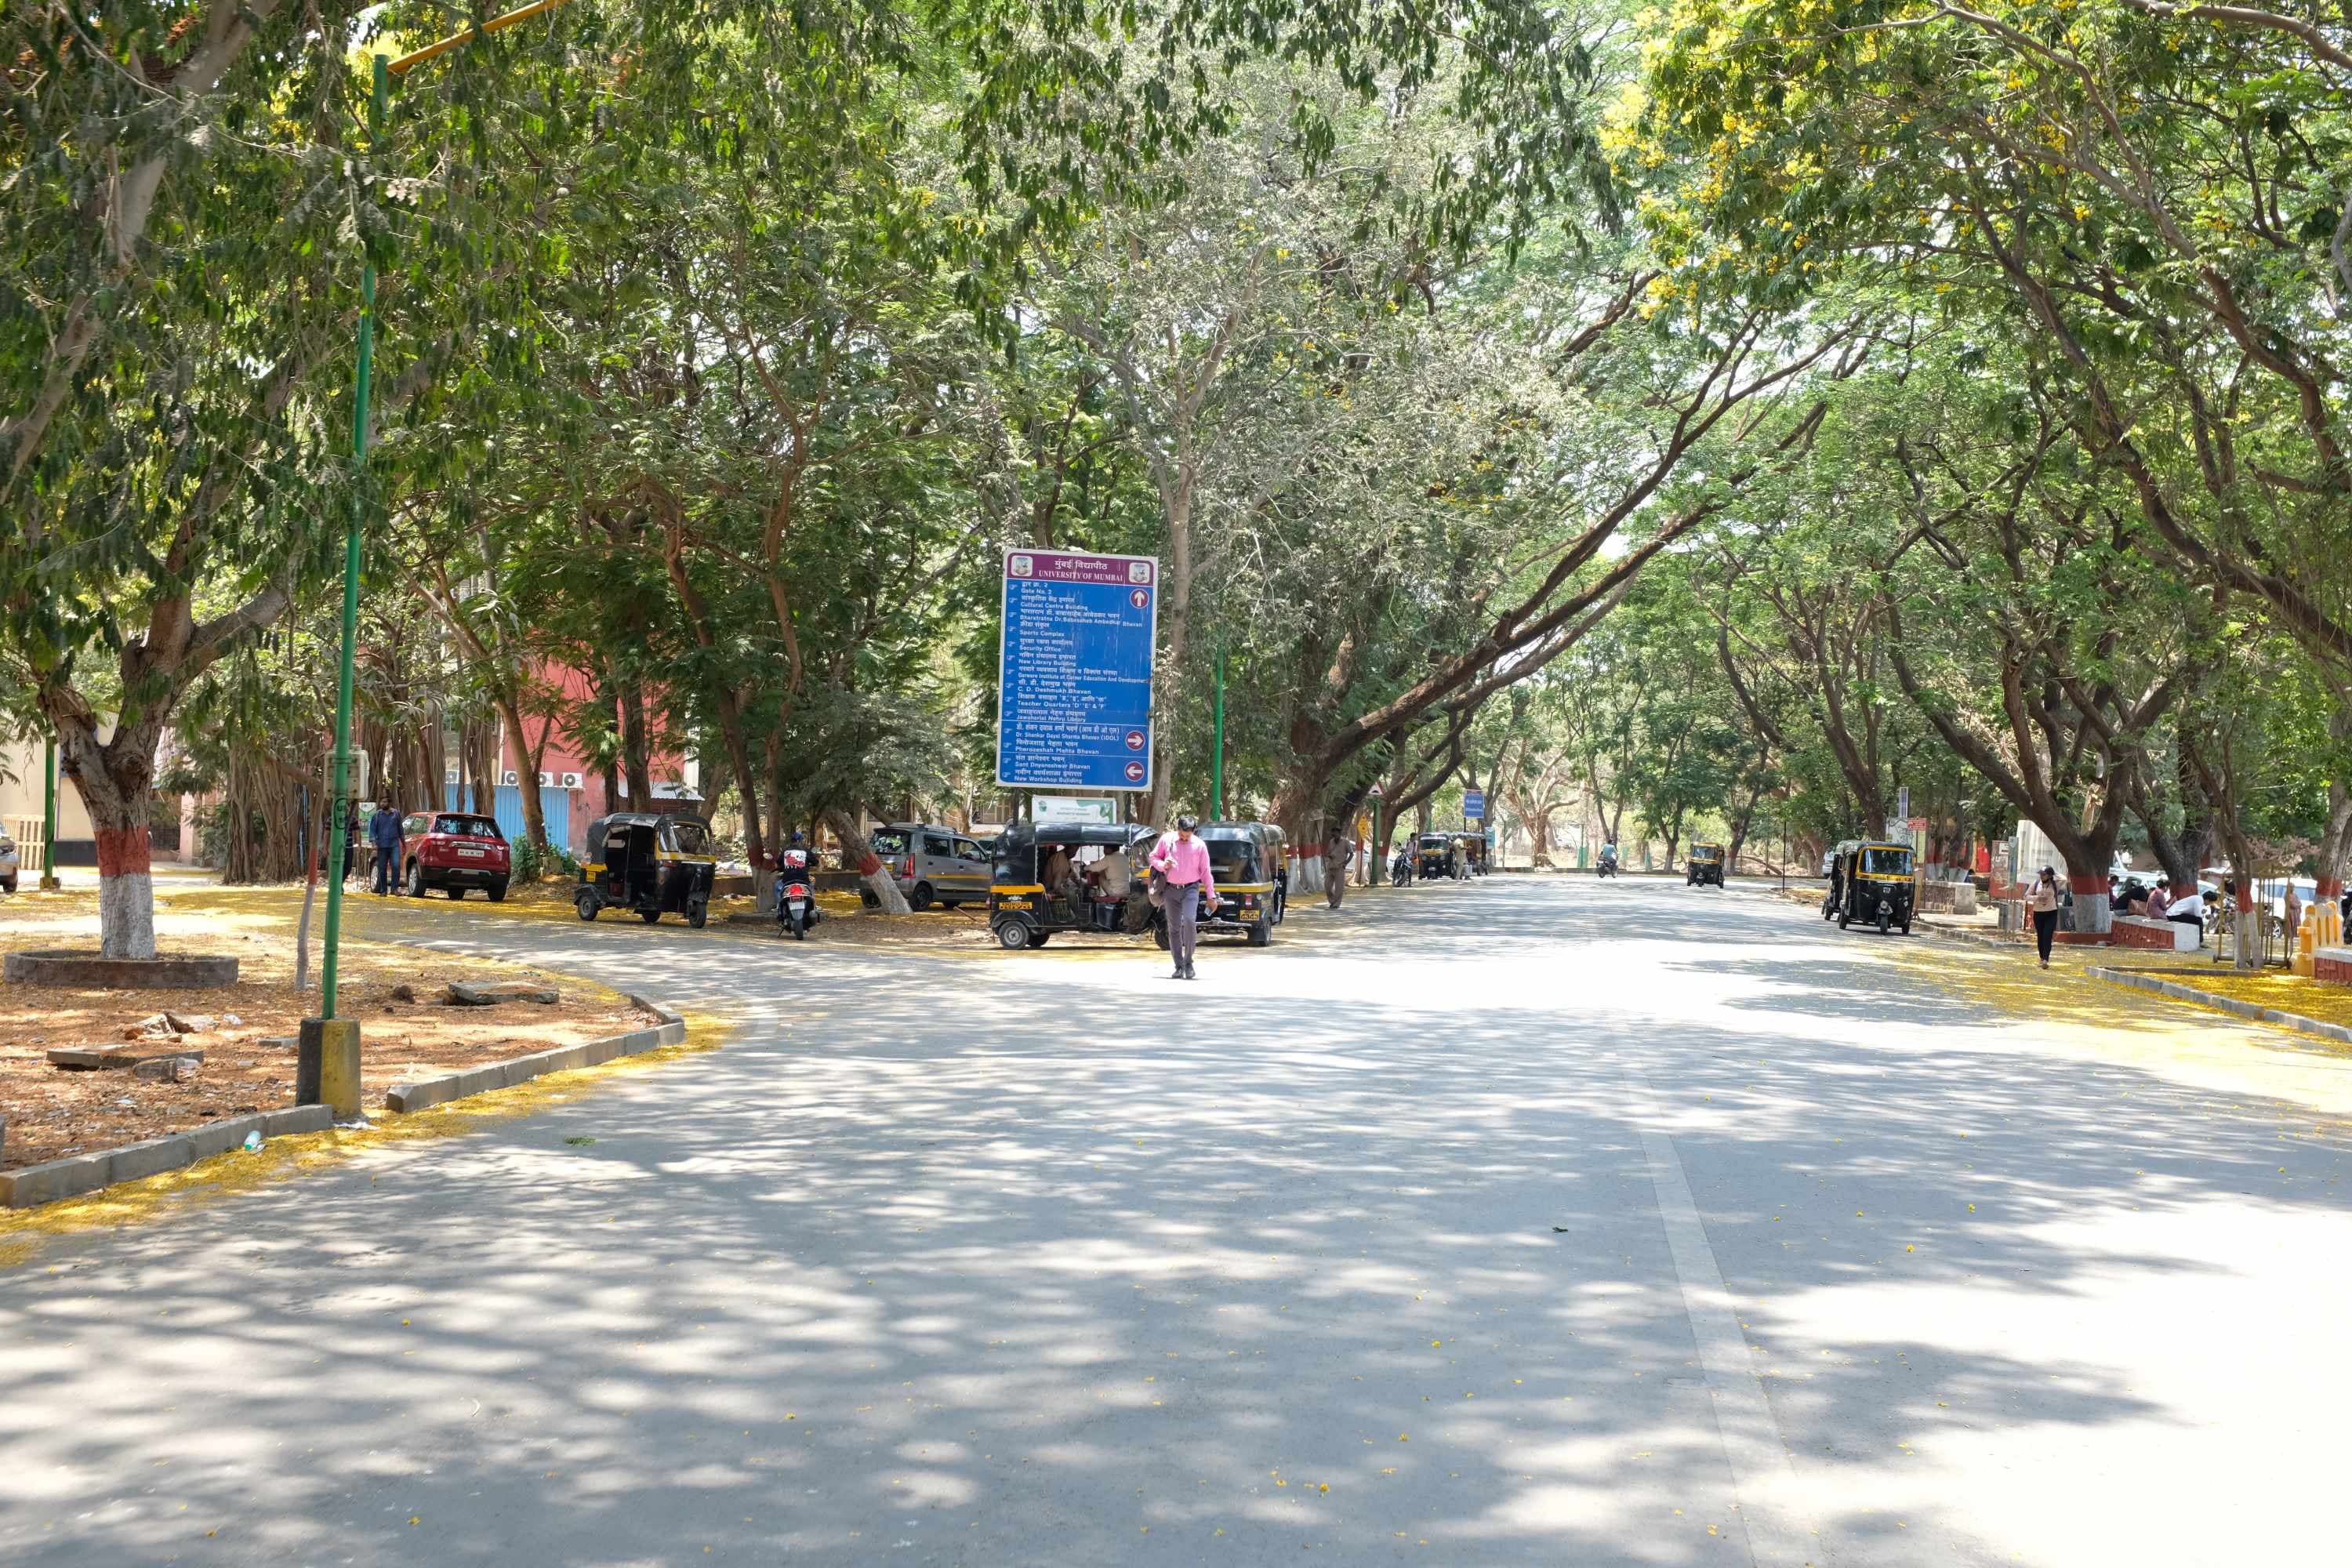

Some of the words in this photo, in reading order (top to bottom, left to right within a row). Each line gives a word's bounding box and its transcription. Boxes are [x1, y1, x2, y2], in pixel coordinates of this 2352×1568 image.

[1054, 558, 1073, 569] मुंबई
[1075, 560, 1108, 570] विद्यापीठ
[1039, 570, 1080, 579] UNIVERSITY
[1094, 573, 1123, 582] MUMBAI
